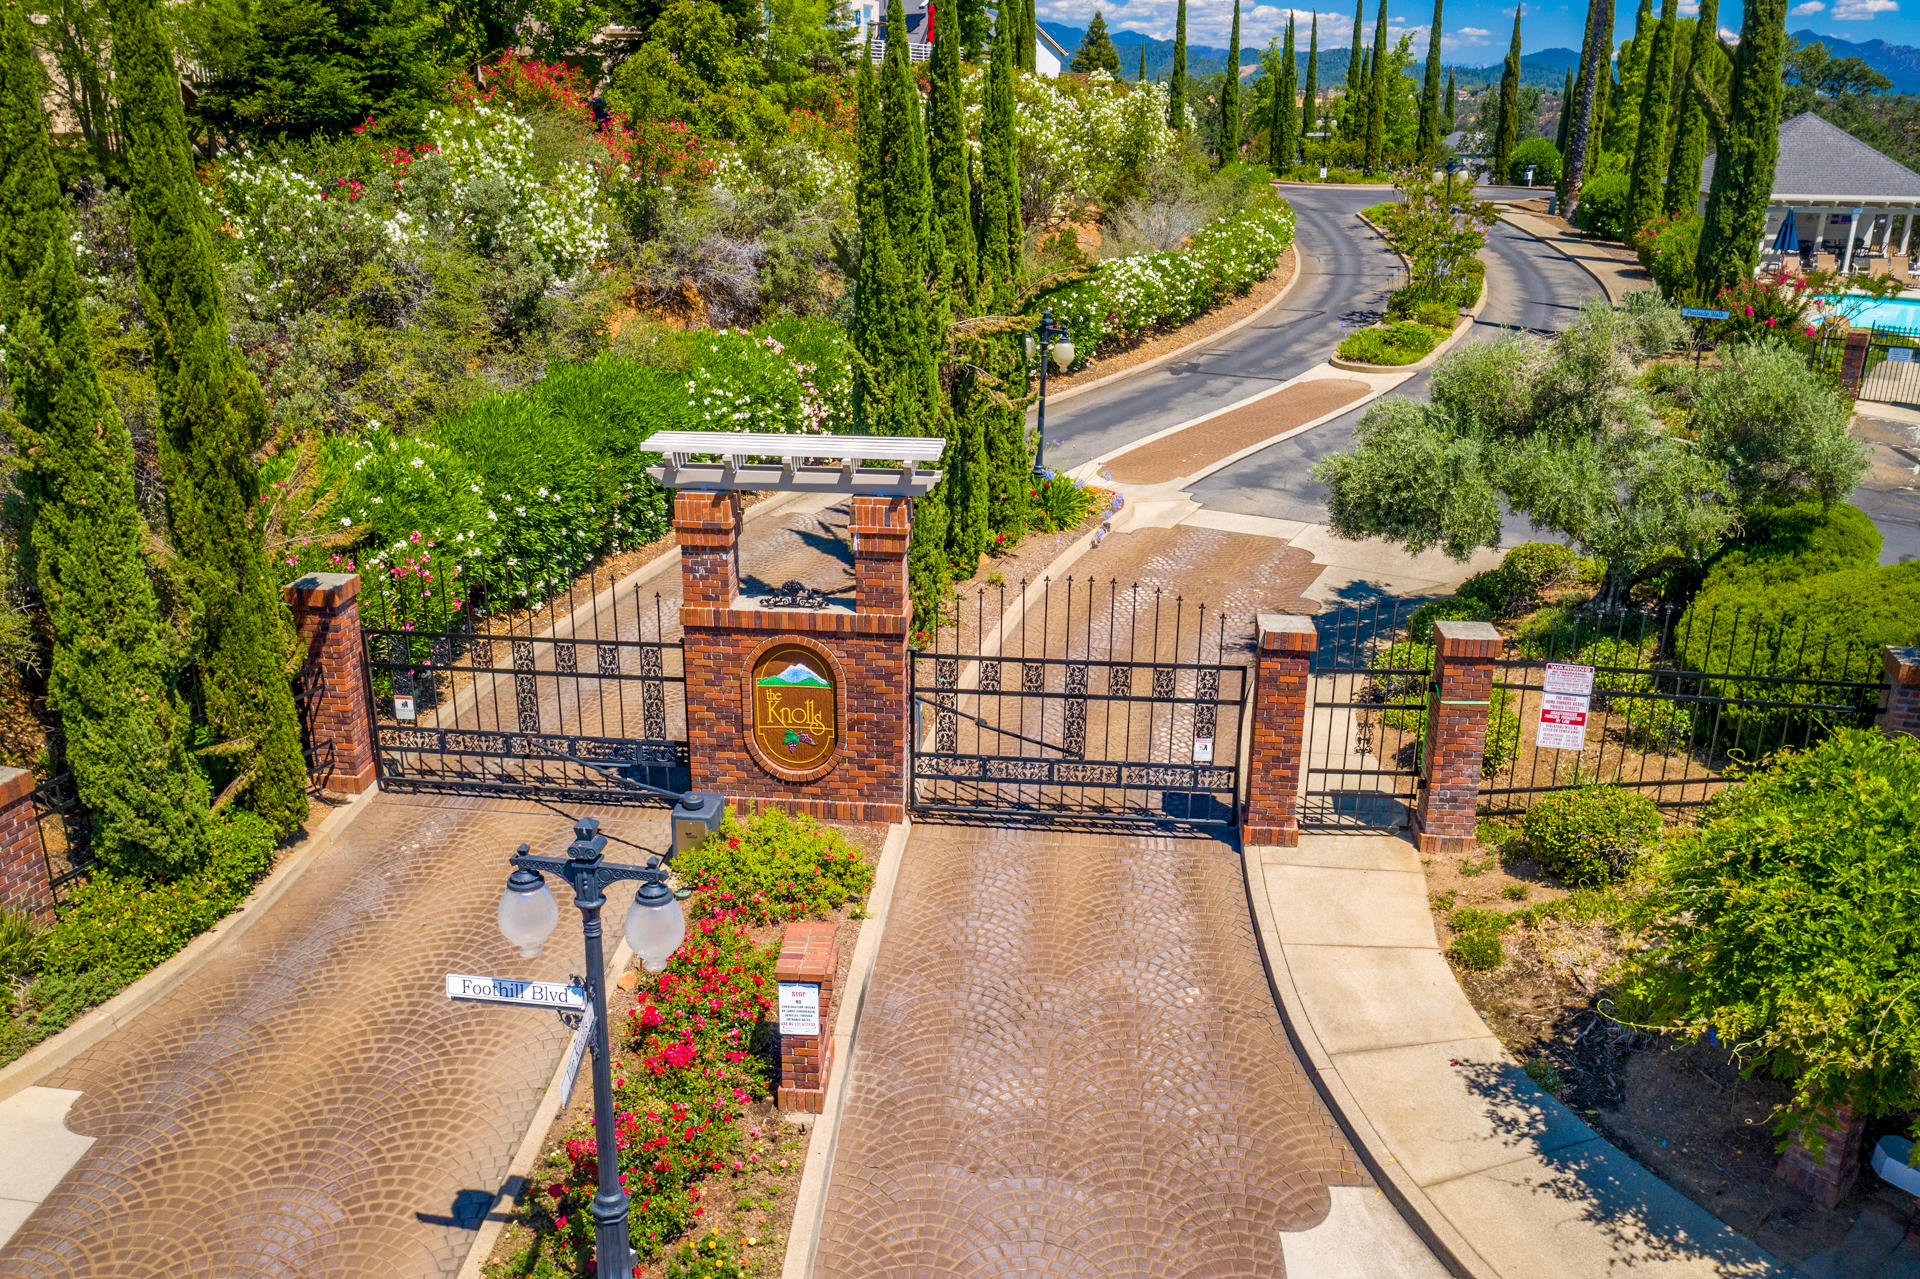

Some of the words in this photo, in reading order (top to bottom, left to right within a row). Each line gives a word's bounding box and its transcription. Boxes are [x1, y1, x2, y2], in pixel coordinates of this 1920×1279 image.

[766, 689, 782, 700] the
[766, 699, 825, 735] Knolls
[462, 979, 524, 999] Foothill
[532, 985, 568, 1002] Blvd
